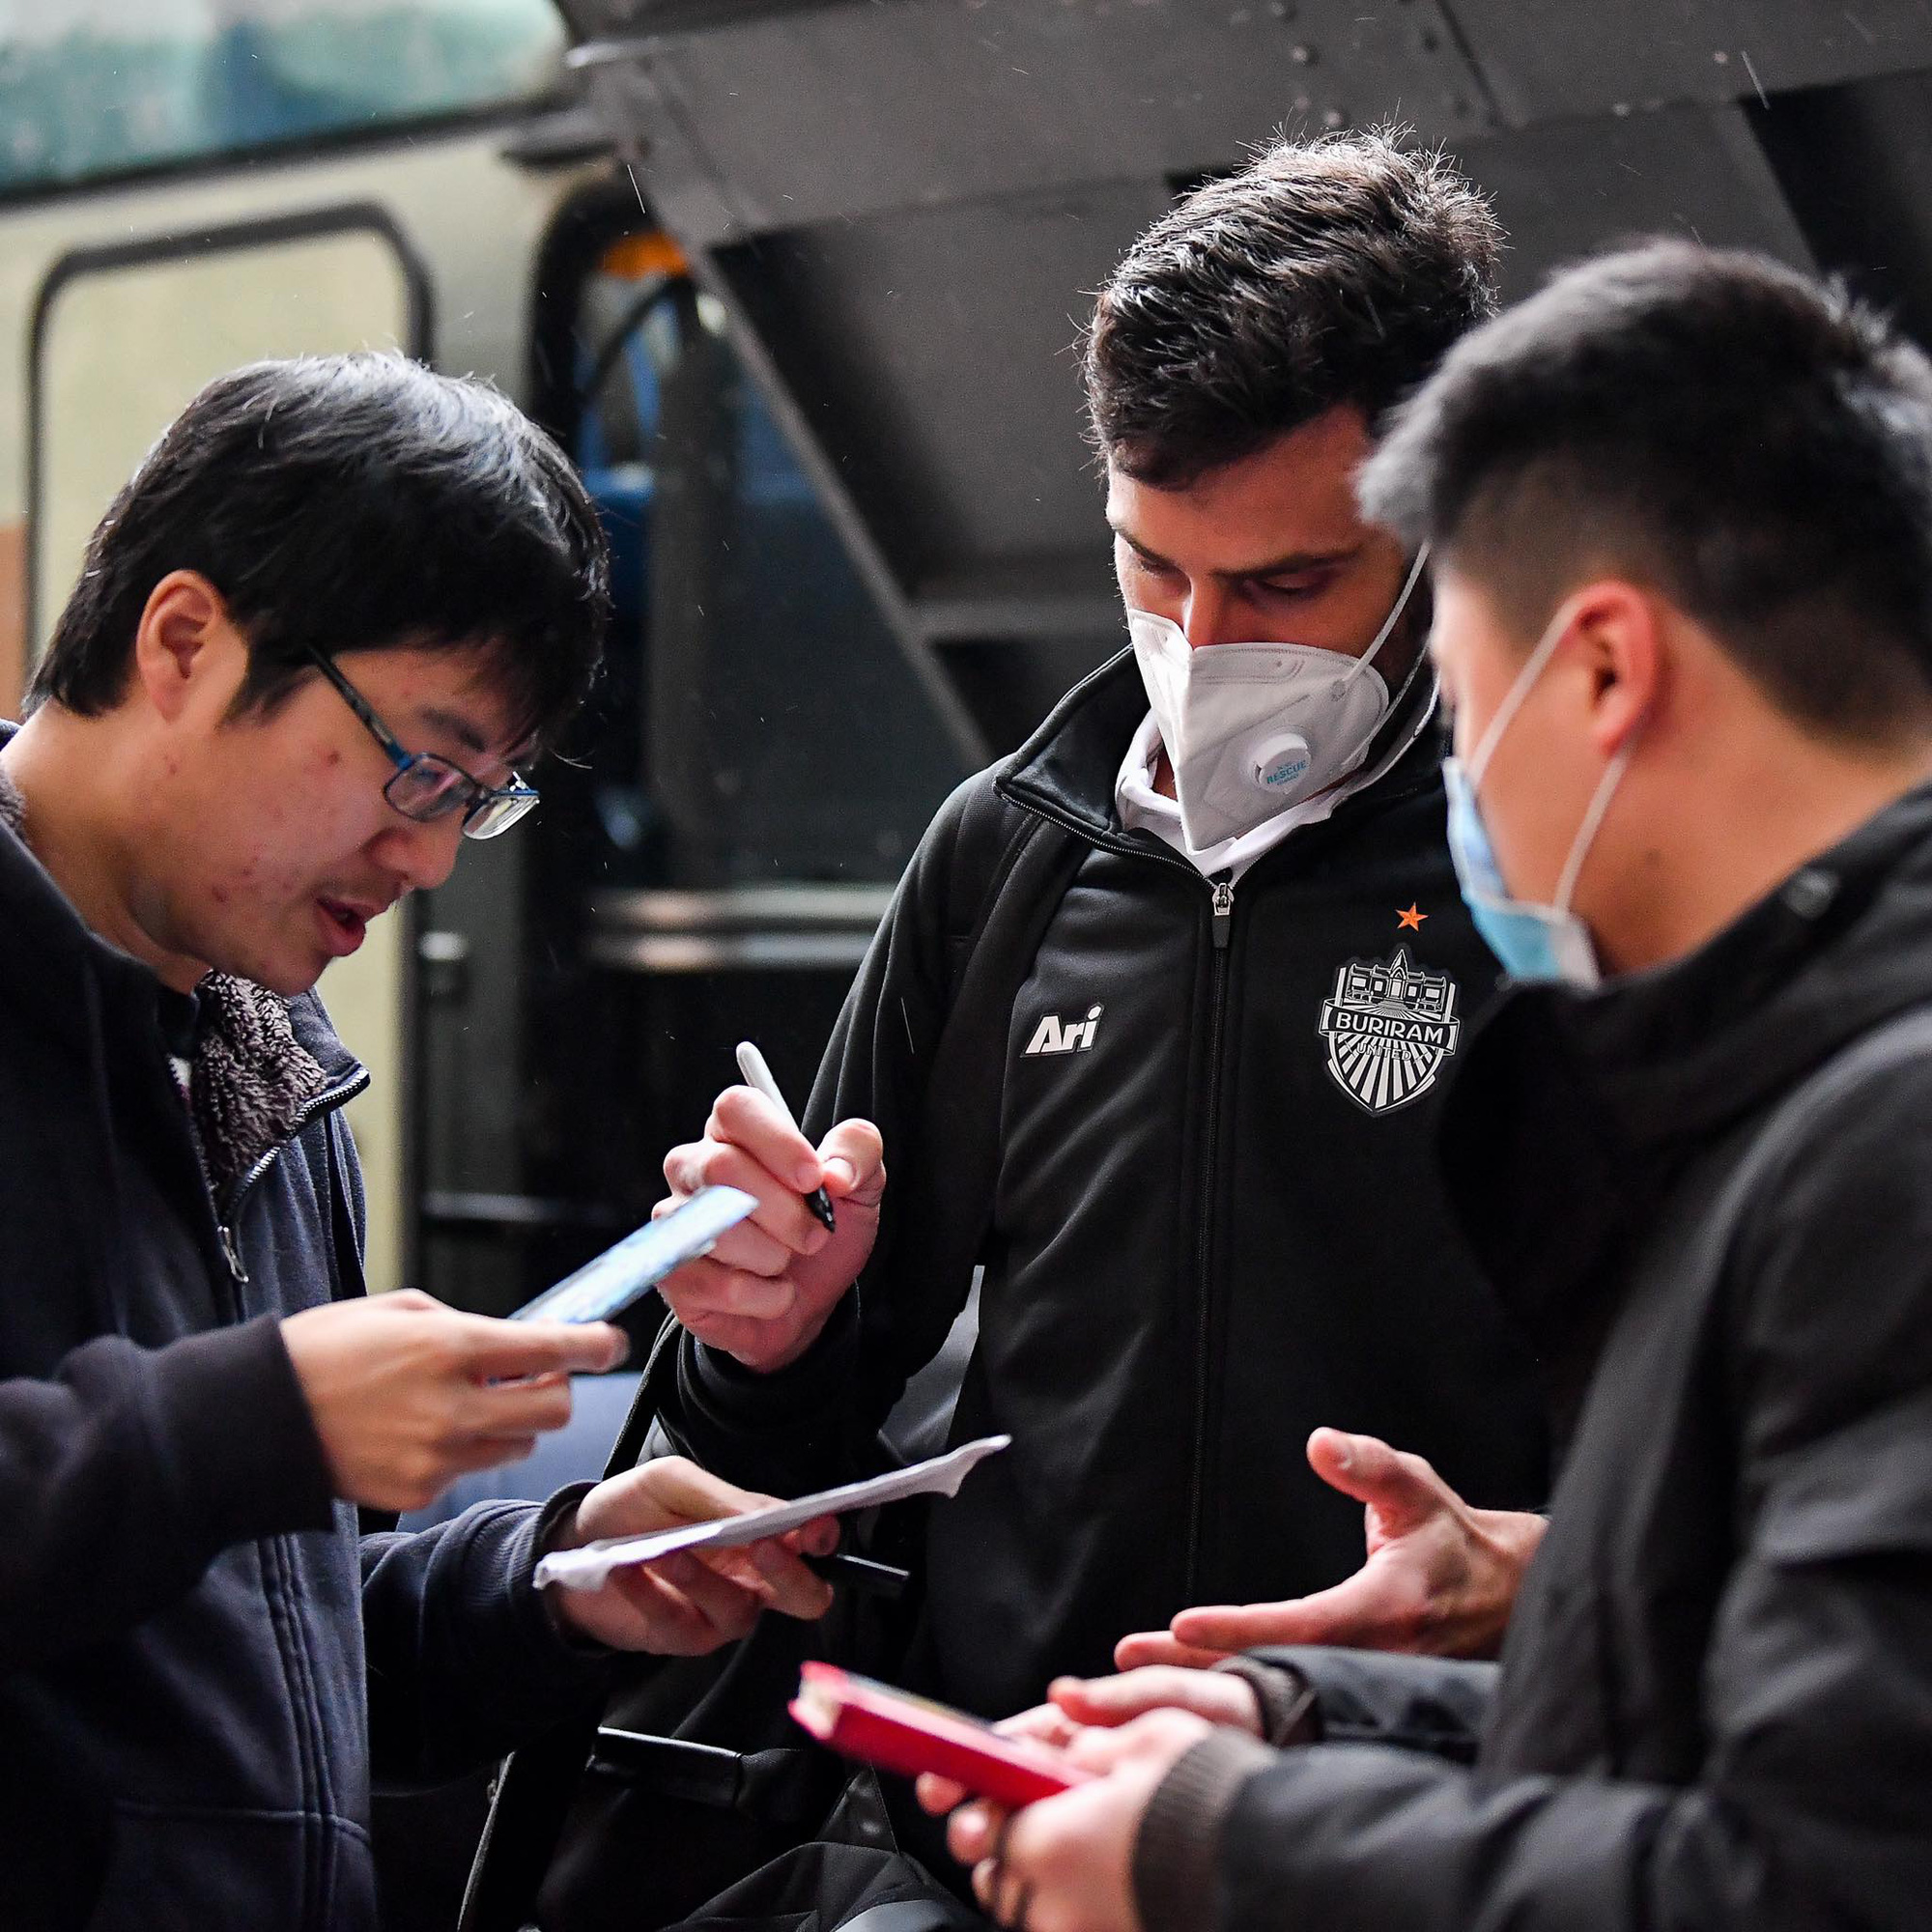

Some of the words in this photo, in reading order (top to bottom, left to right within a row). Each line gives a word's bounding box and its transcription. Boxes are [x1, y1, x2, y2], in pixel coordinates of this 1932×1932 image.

[1266, 760, 1307, 783] RESCUE
[1024, 1006, 1101, 1054] Ari
[1335, 1011, 1444, 1044] BURIRAM
[1356, 1042, 1412, 1061] UNITED
